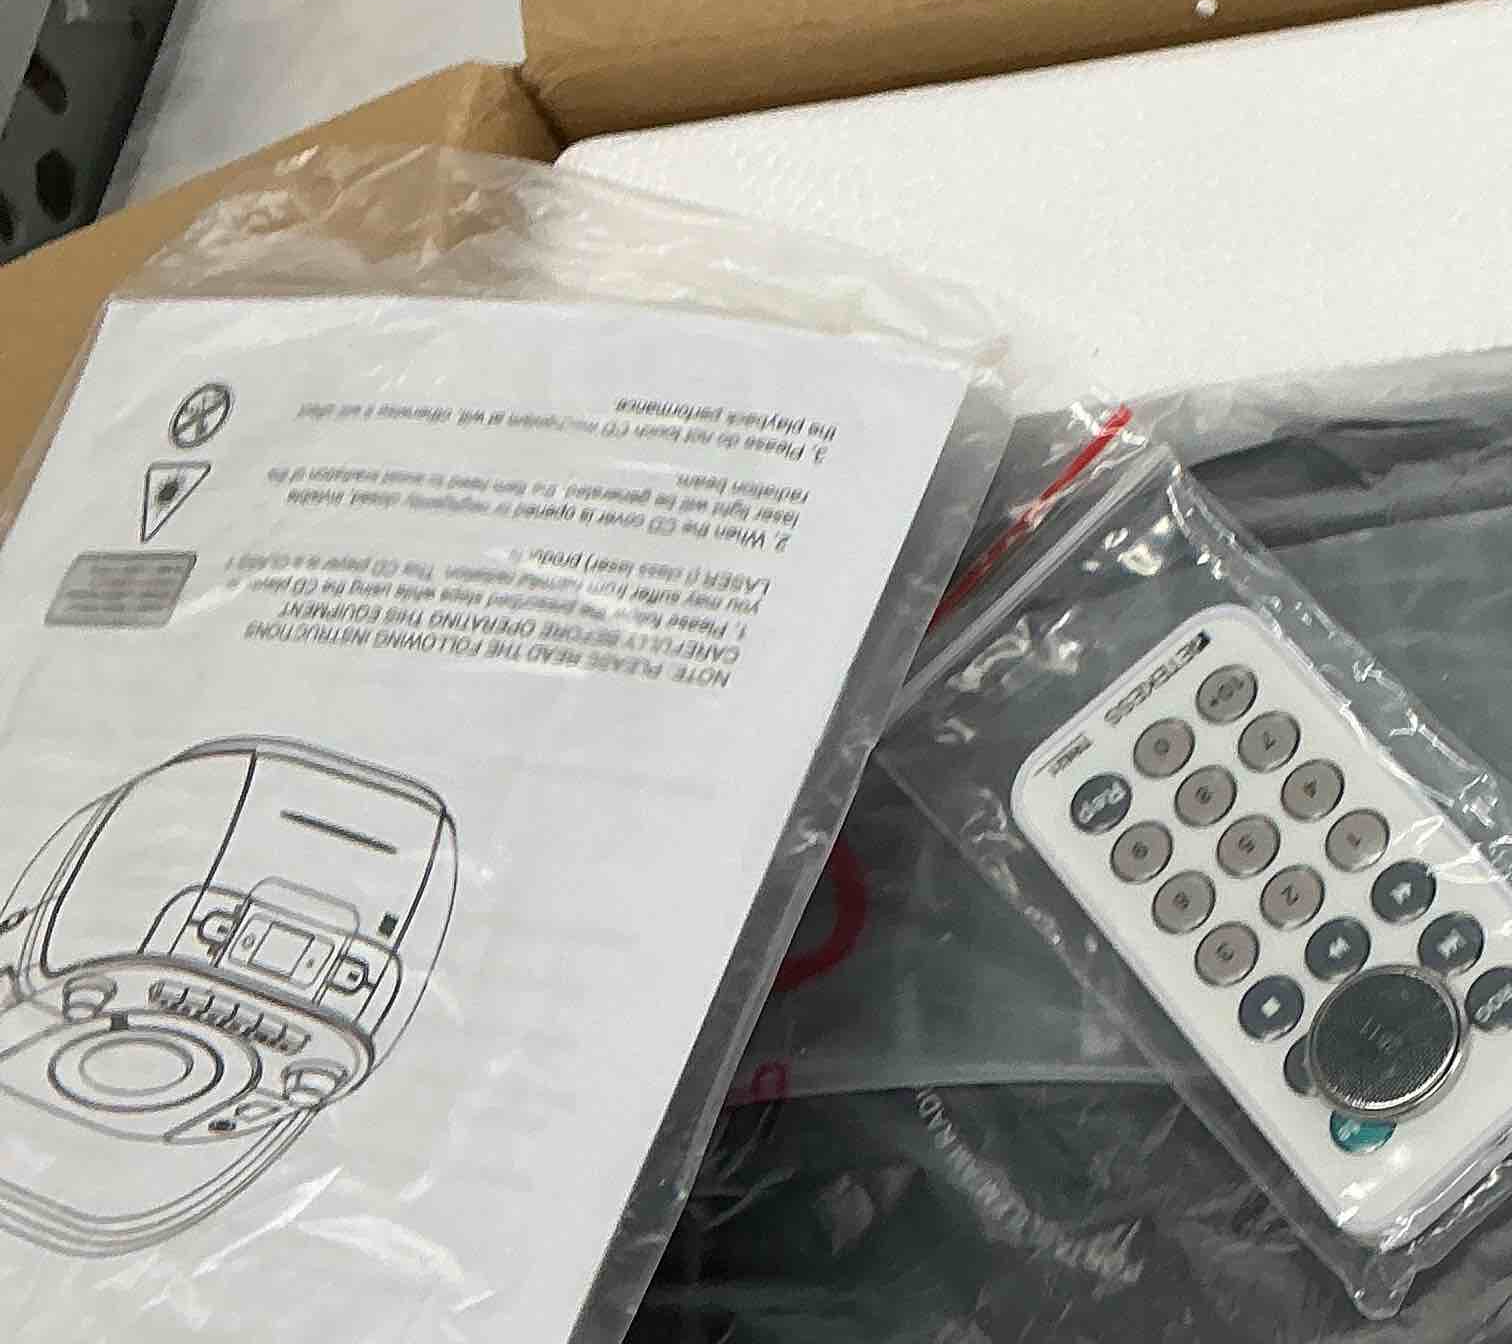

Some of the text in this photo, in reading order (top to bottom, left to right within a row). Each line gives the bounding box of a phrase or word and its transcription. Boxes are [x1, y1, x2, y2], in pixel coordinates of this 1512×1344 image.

[634, 424, 682, 444] touch
[725, 411, 806, 438] playback
[807, 421, 839, 443] the
[682, 429, 714, 447] not
[716, 434, 741, 452] do
[742, 438, 807, 463] Please
[654, 494, 677, 512] be
[731, 481, 810, 506] radiation
[512, 501, 577, 523] opened
[679, 498, 709, 517] will
[712, 500, 752, 521] light
[753, 507, 801, 530] laser
[596, 510, 646, 529] cover
[647, 516, 678, 536] CD
[681, 520, 712, 539] the
[713, 524, 768, 549] When
[371, 559, 399, 579] CD
[583, 553, 635, 578] laser)
[638, 563, 684, 583] class
[292, 576, 319, 595] CD
[321, 580, 346, 597] the
[348, 577, 392, 599] using
[392, 583, 437, 604] while
[587, 580, 629, 602] from
[704, 570, 771, 596] LASER
[439, 586, 483, 608] steps
[630, 587, 682, 607] suffer
[684, 591, 723, 613] may
[725, 595, 763, 617] you
[383, 607, 424, 627] THIS
[429, 611, 536, 636] OPERATING
[668, 615, 728, 639] Please
[244, 621, 372, 647] INSTRUCTIONS
[375, 631, 483, 657] FOLLOWING
[539, 624, 621, 650] BEFORE
[485, 640, 522, 661] THE
[527, 644, 583, 668] READ
[625, 637, 740, 665] CAREFULLY
[587, 655, 662, 681] PLEASE
[1280, 884, 1300, 907] 2
